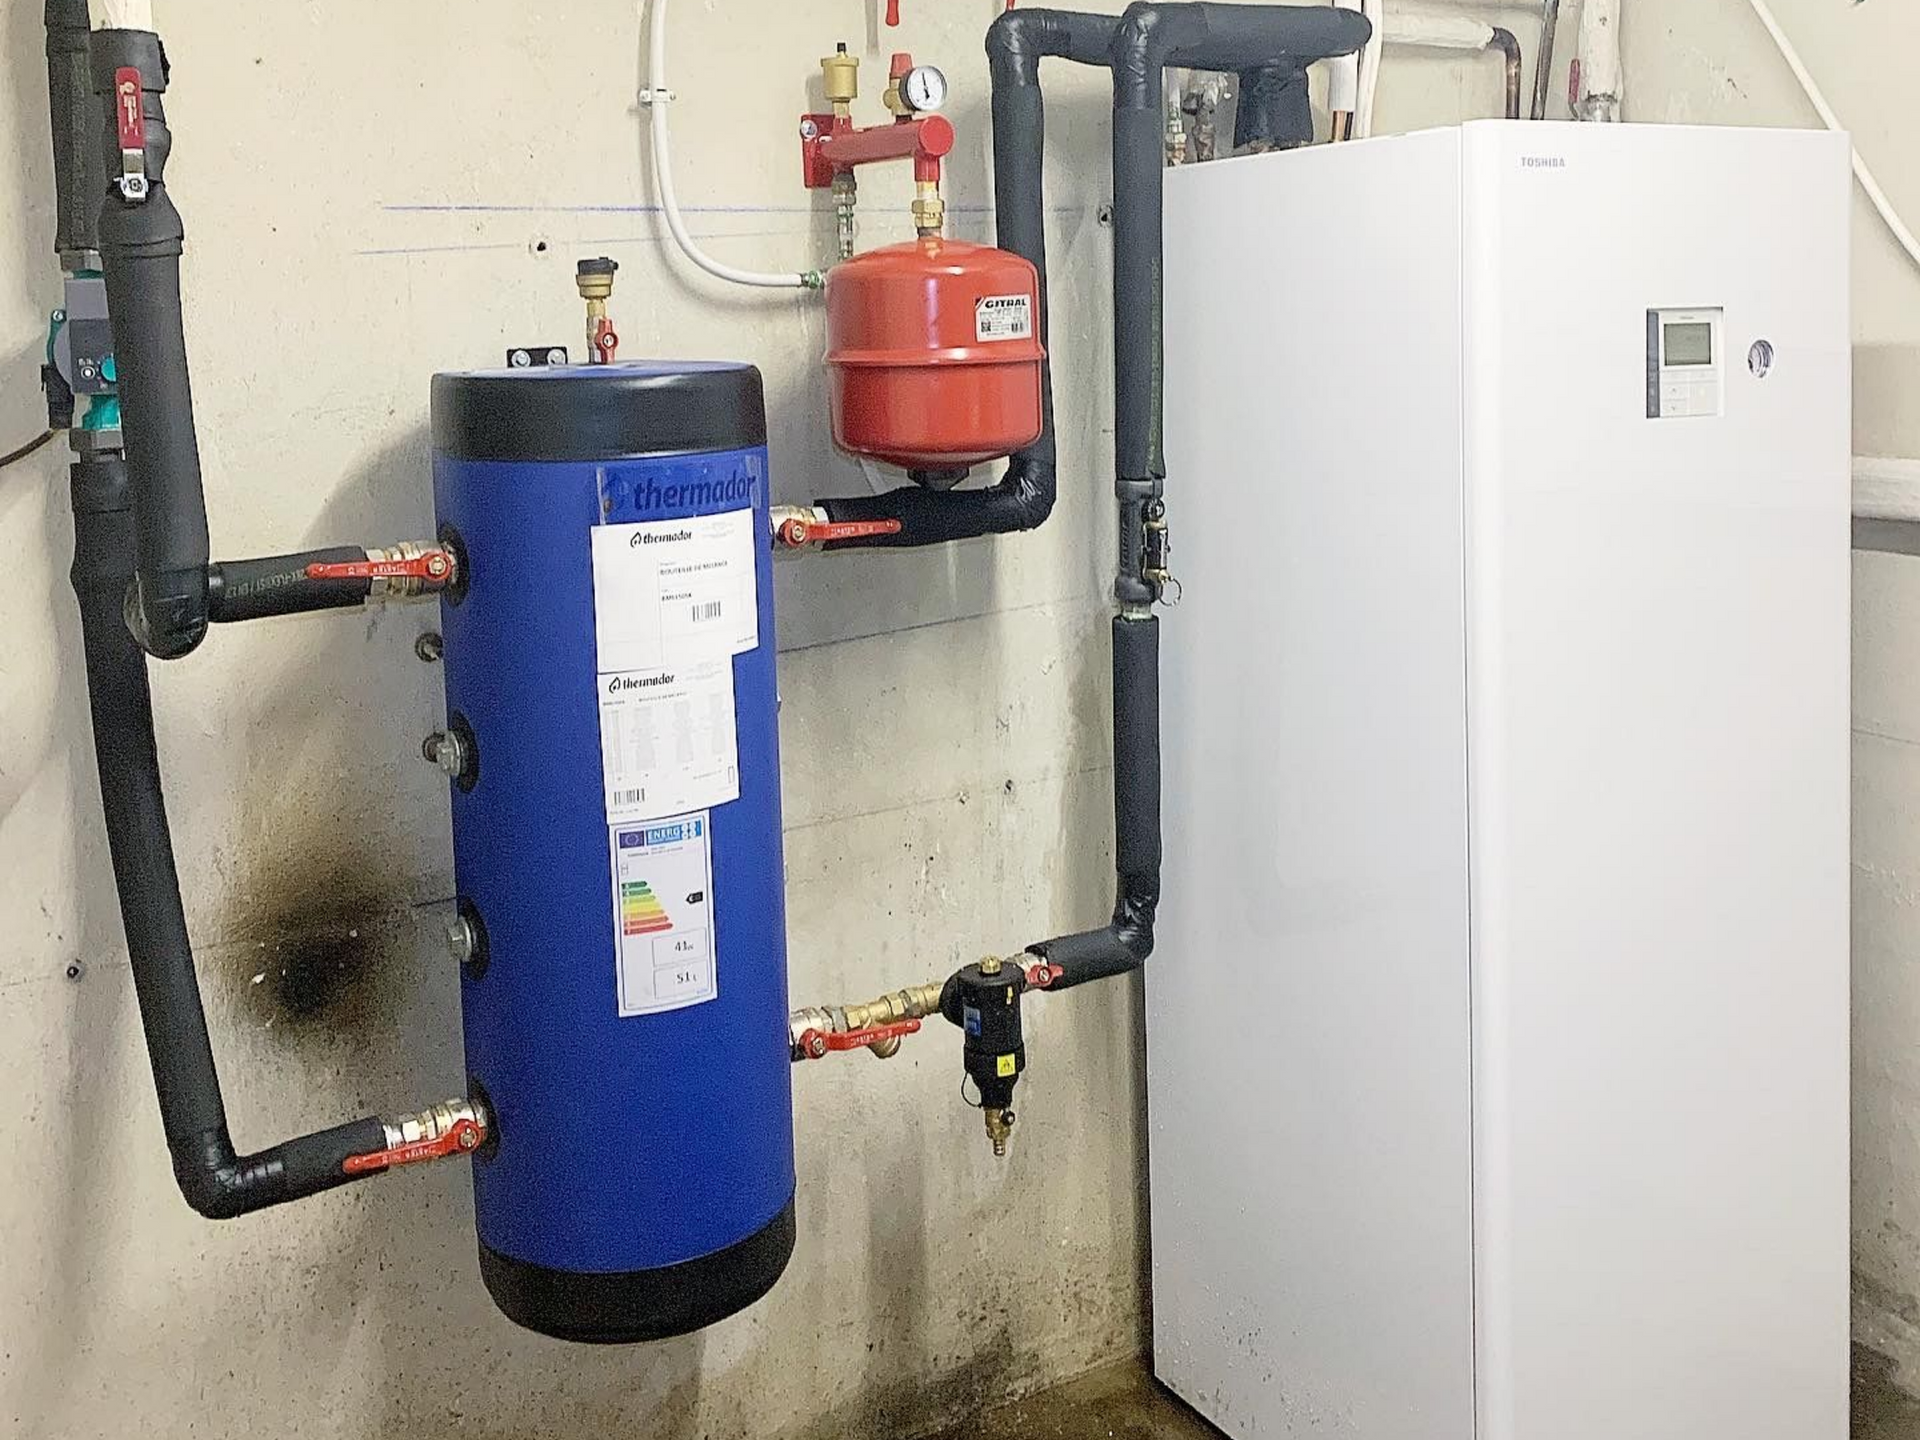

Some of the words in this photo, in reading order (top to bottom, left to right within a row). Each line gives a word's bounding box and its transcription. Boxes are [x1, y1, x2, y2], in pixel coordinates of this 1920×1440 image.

[1521, 157, 1565, 167] TOSHIBA
[633, 471, 756, 510] thermador
[644, 530, 692, 545] thermador
[623, 673, 675, 690] thermador
[647, 827, 680, 841] ENERG
